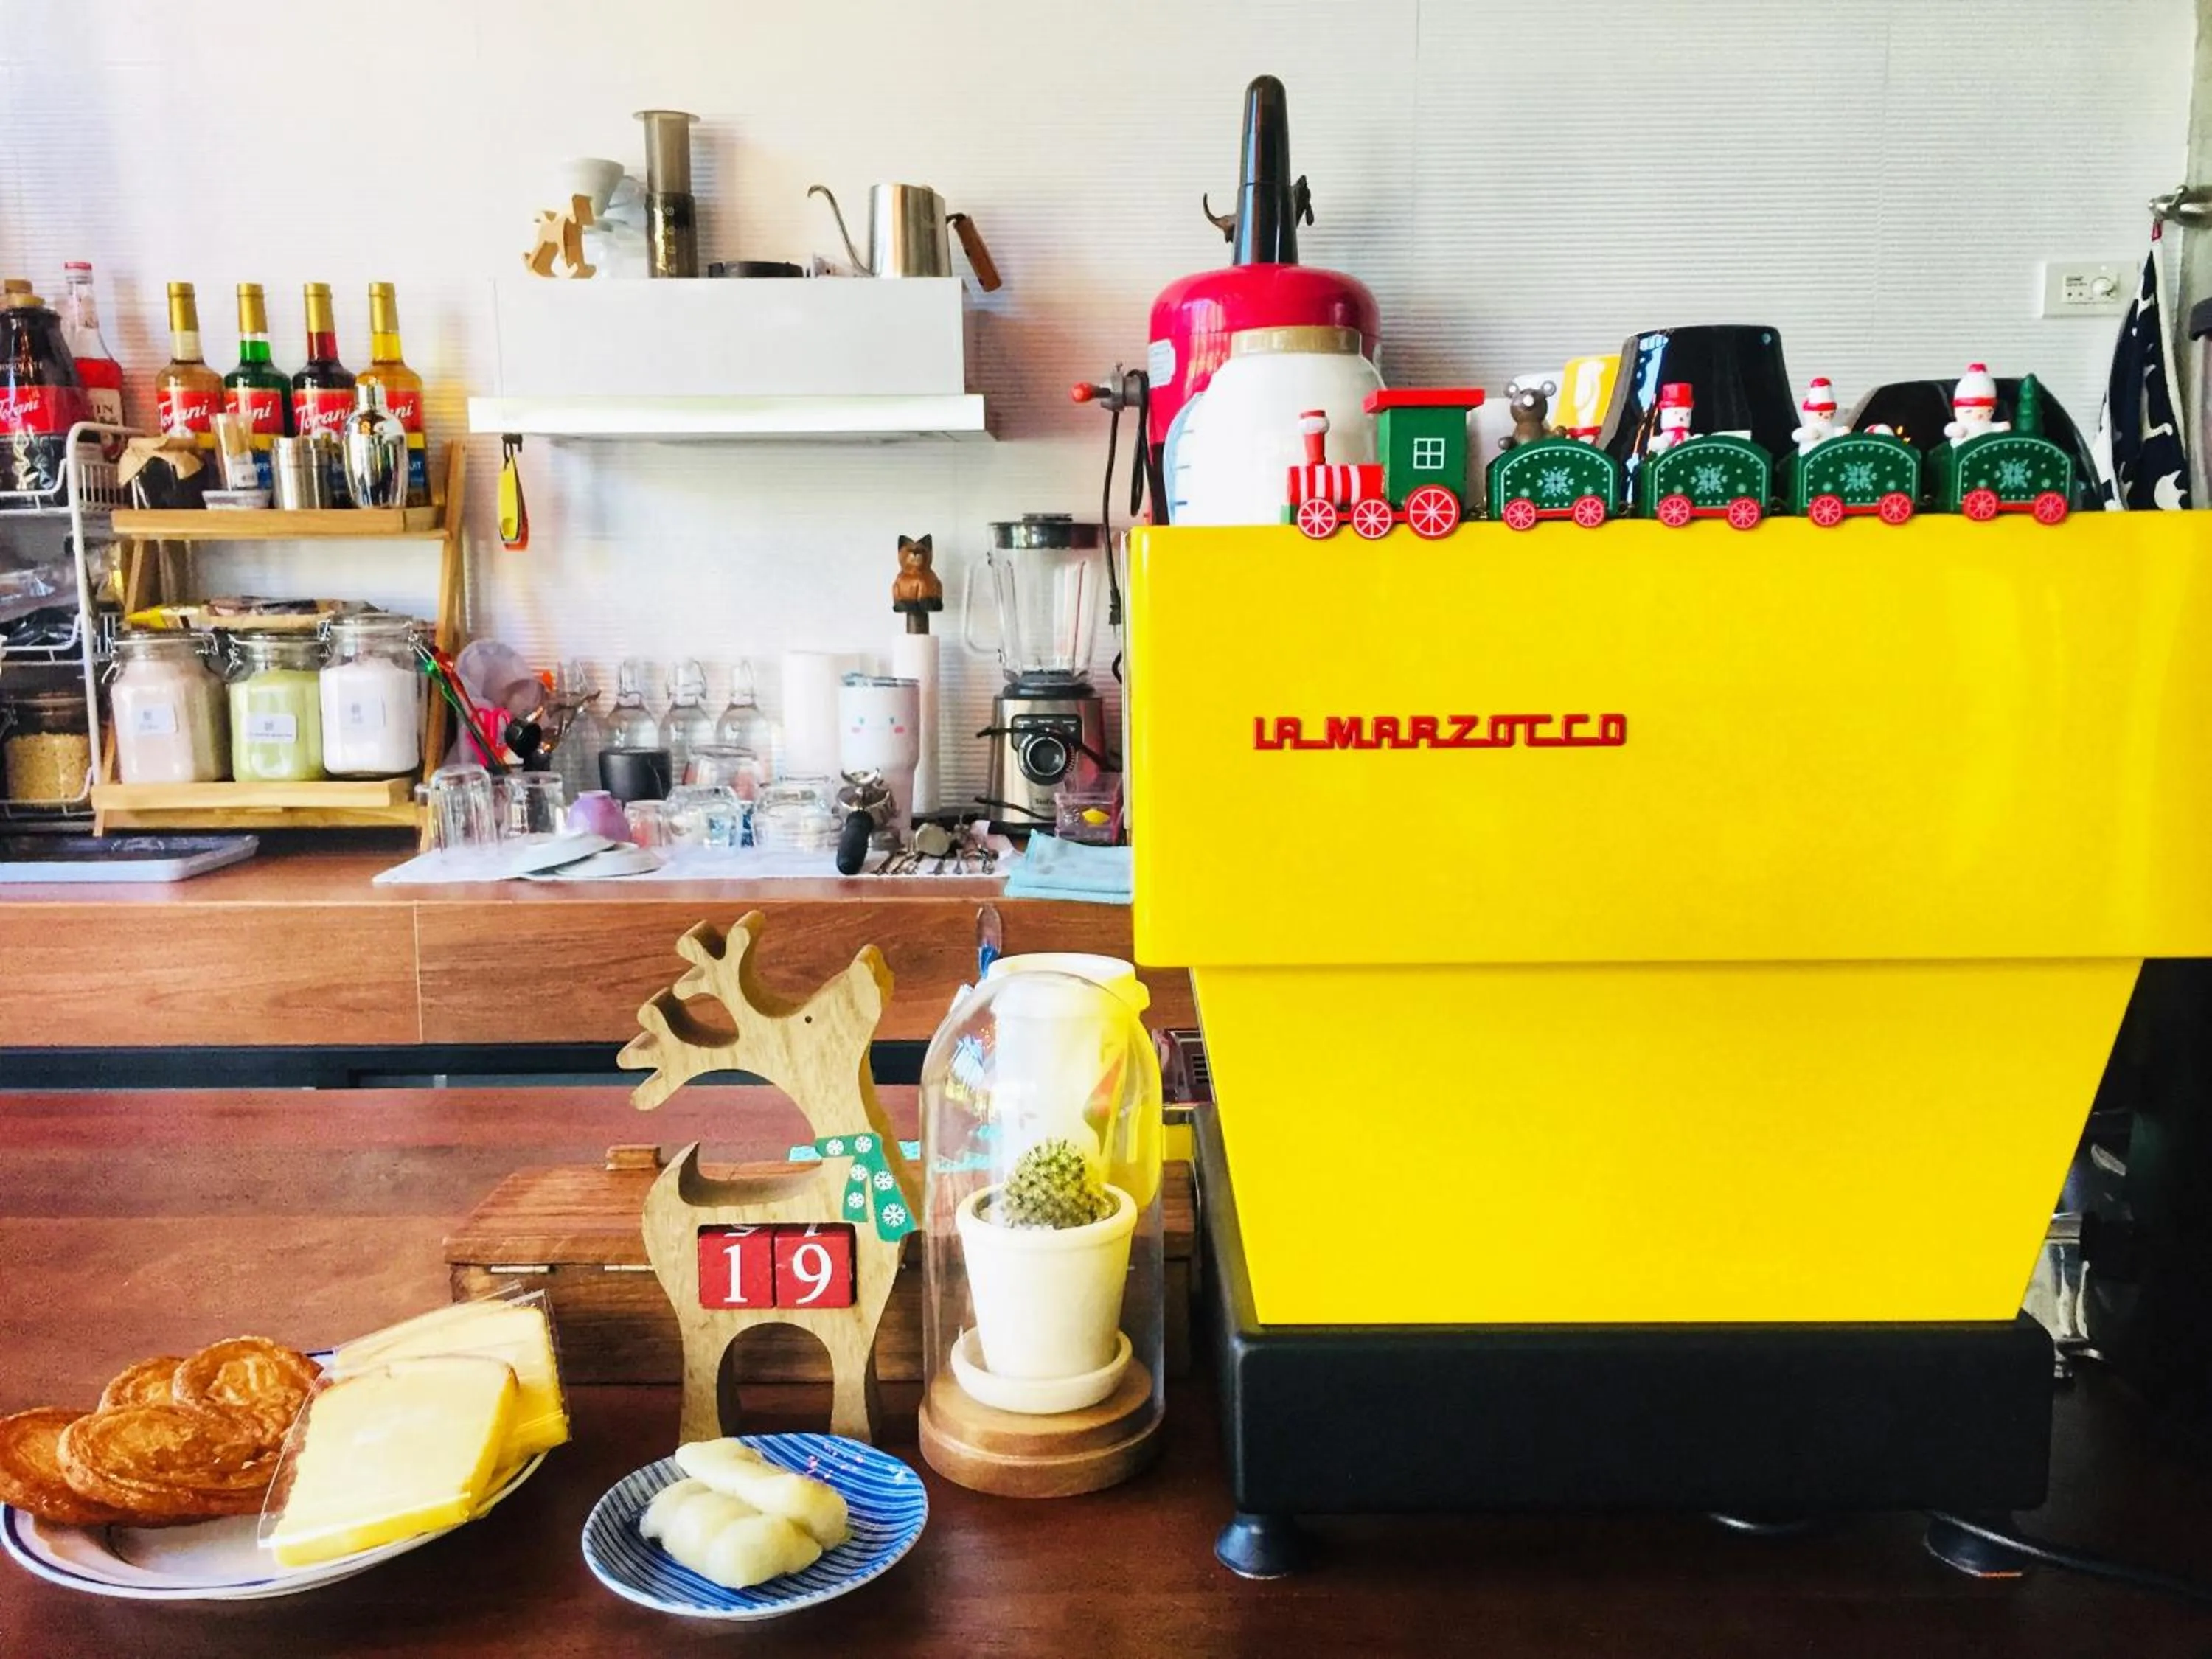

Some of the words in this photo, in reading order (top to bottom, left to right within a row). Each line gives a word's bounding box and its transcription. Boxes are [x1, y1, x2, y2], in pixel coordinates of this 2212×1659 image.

[159, 399, 209, 434] Toani
[1253, 717, 1301, 749] LA
[1325, 714, 1627, 749] MARZOCCO
